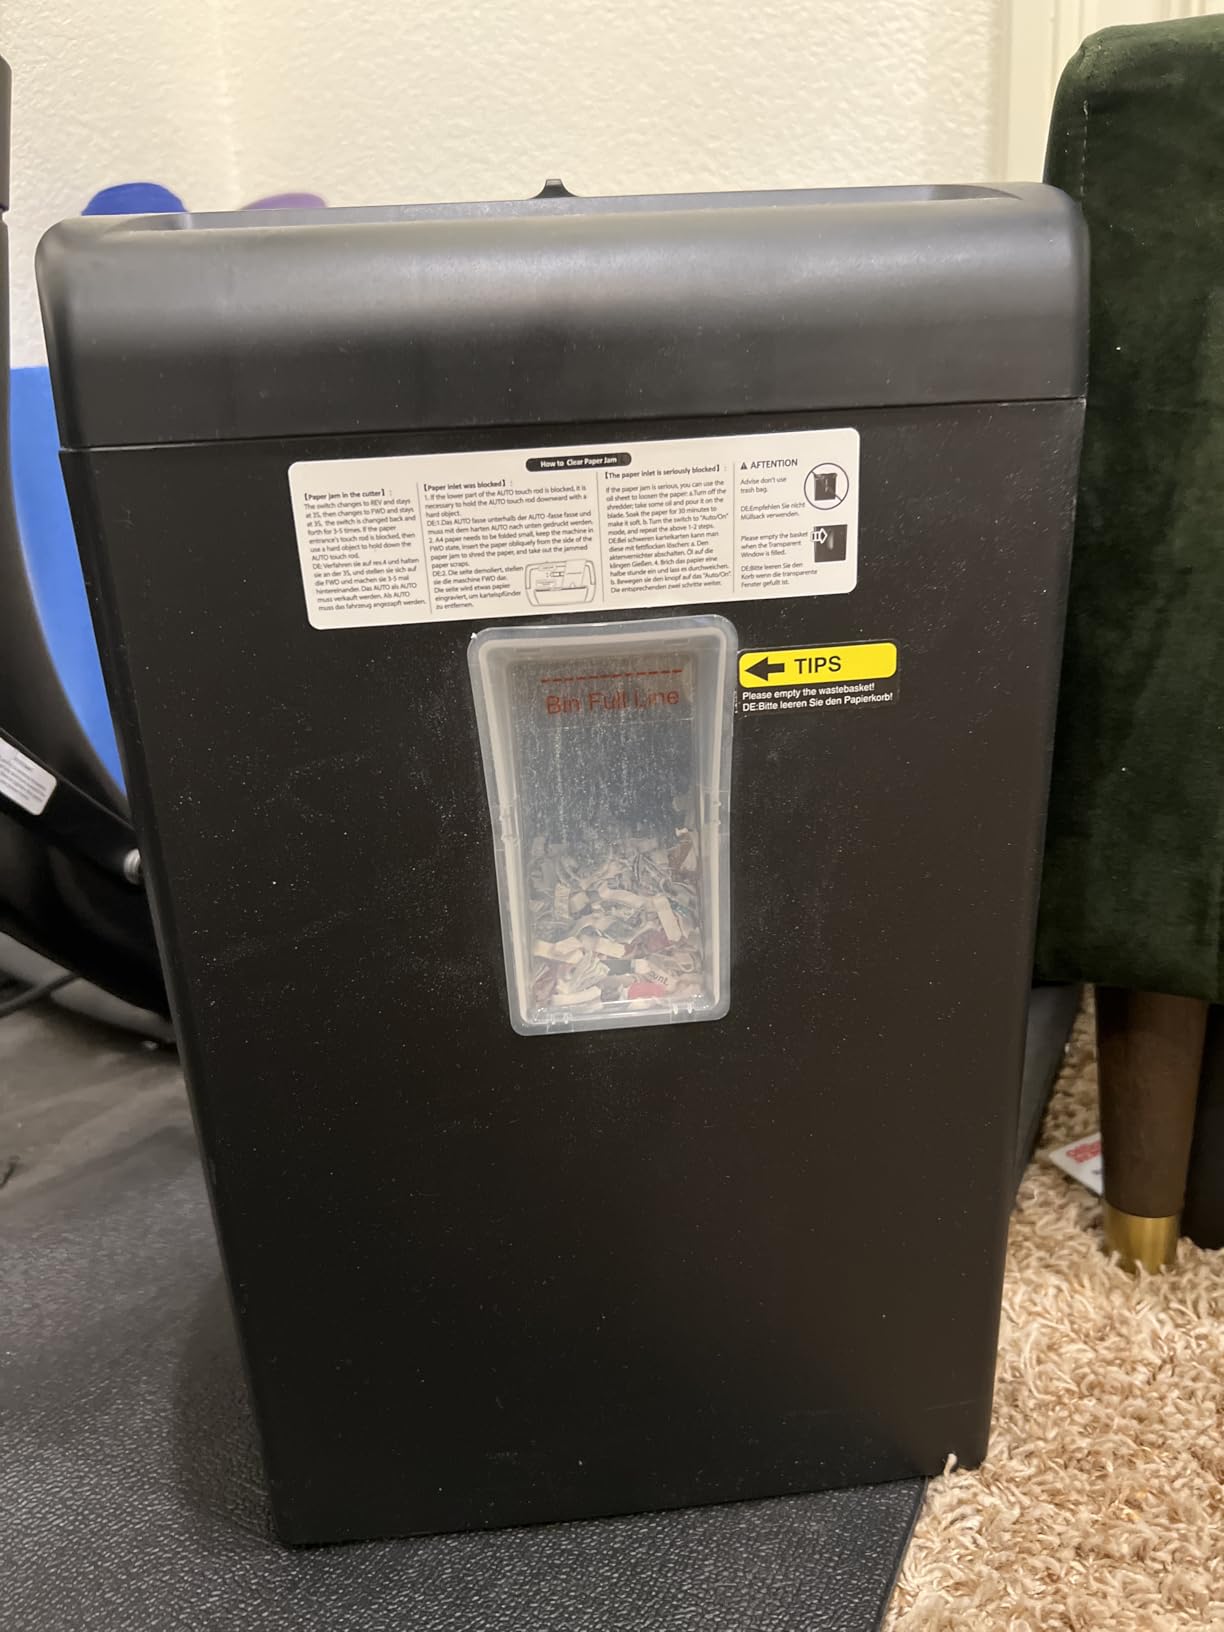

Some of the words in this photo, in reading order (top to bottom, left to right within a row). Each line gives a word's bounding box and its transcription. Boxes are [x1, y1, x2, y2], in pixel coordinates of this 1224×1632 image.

[540, 460, 556, 468] How
[584, 457, 603, 466] Paper
[604, 456, 617, 464] Jam
[794, 655, 842, 674] TIPS
[742, 690, 772, 700] Please
[774, 689, 801, 699] empty
[802, 687, 817, 696] the
[818, 682, 875, 695] wastebasket!
[546, 695, 580, 715] Bin
[588, 691, 626, 711] Full
[634, 689, 680, 708] Line
[742, 701, 778, 712] DE:Bitte
[780, 699, 807, 709] leeren
[809, 697, 823, 707] Sie
[825, 696, 842, 706] den
[844, 692, 893, 704] Papierkorb!
